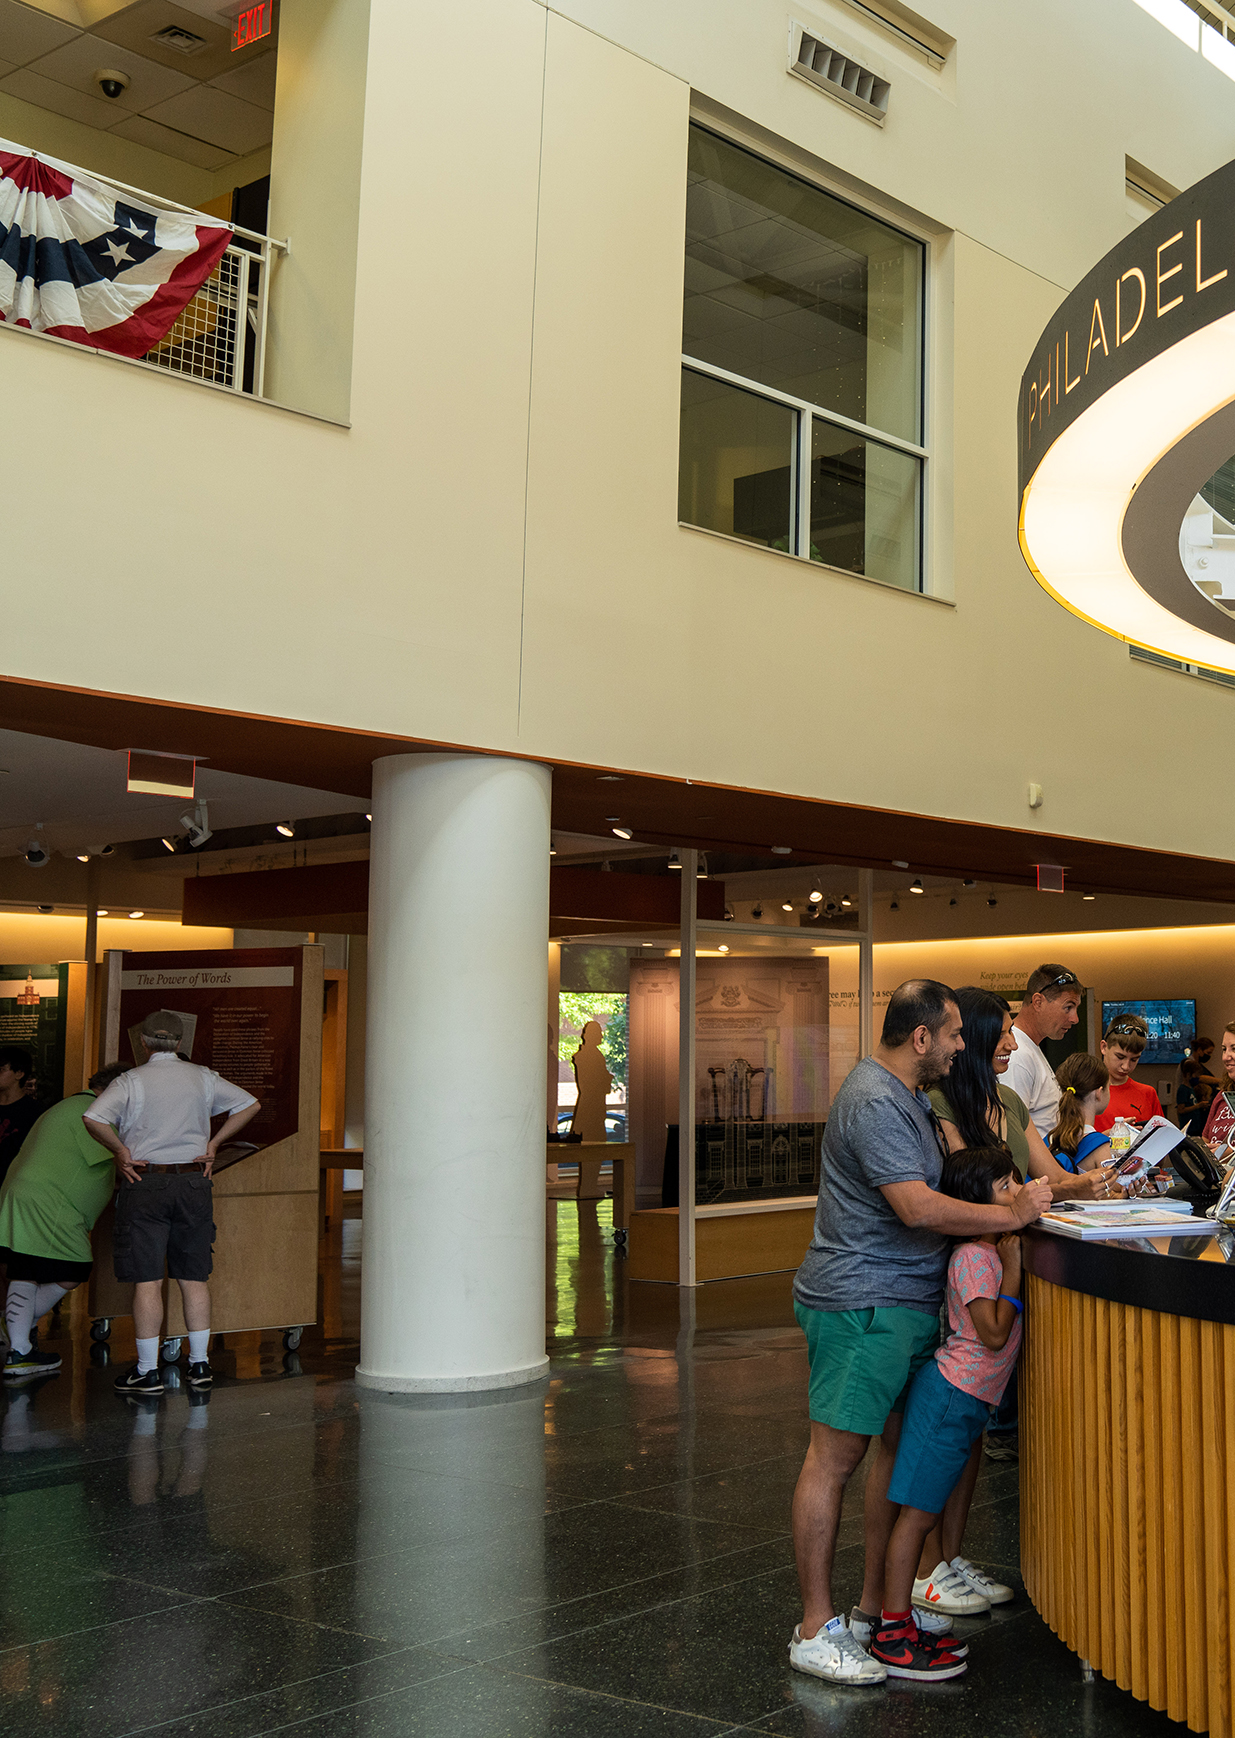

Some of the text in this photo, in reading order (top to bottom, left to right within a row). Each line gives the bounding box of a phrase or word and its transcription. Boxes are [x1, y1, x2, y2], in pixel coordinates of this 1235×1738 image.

[238, 3, 265, 45] EXIT
[137, 972, 232, 987] The Power of Words
[980, 971, 1029, 981] Keep your eyes
[840, 991, 856, 1001] may
[1158, 1015, 1173, 1024] Hall
[1164, 1031, 1181, 1040] 11:40
